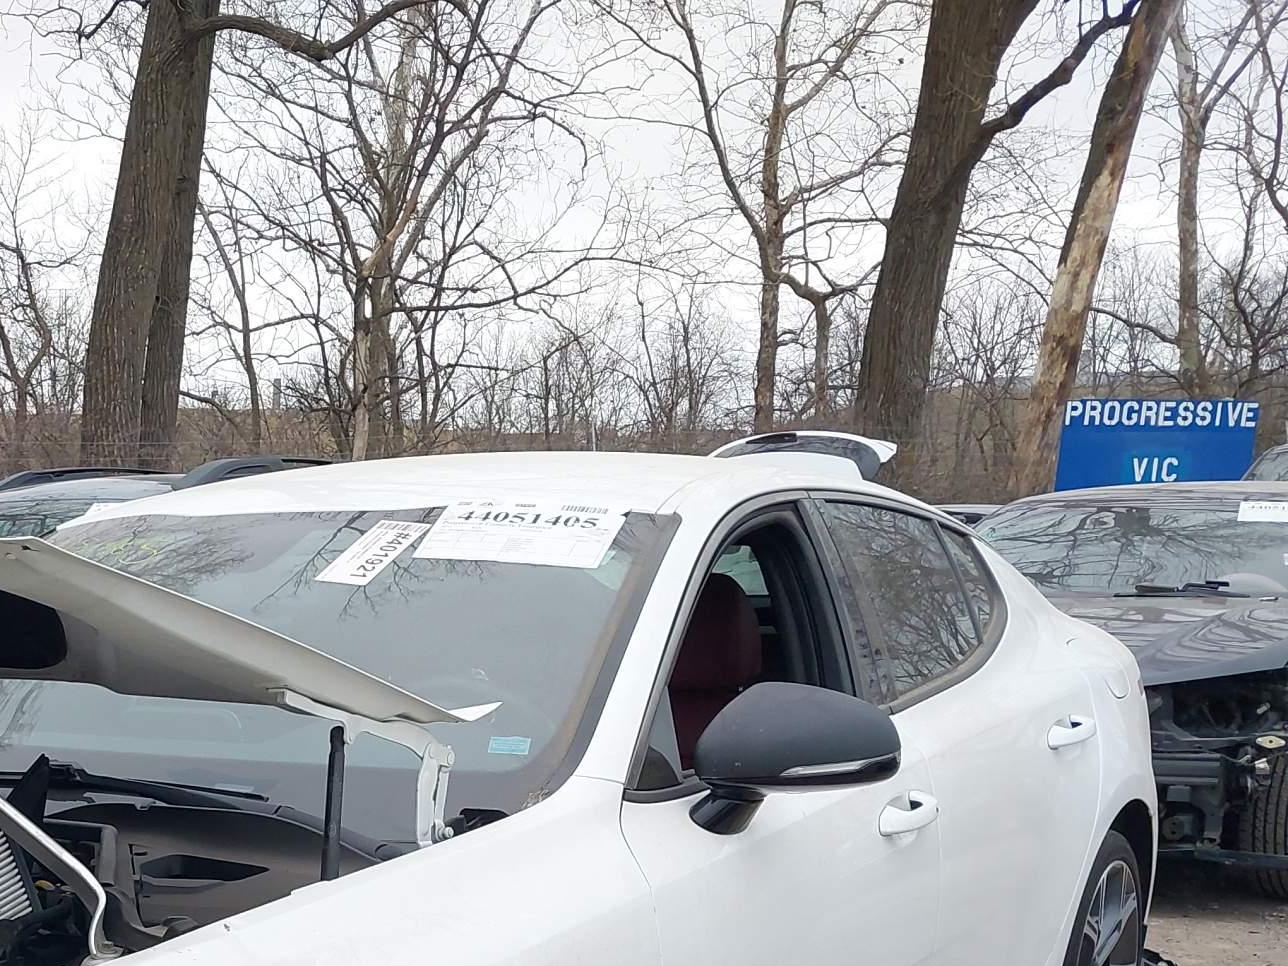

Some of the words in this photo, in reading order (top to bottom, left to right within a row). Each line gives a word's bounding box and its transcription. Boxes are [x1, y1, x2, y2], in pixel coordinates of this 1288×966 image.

[1065, 400, 1259, 427] PROGRESSIVE
[1133, 457, 1179, 482] VIC
[457, 510, 600, 529] 44051405
[350, 532, 412, 578] #401921
